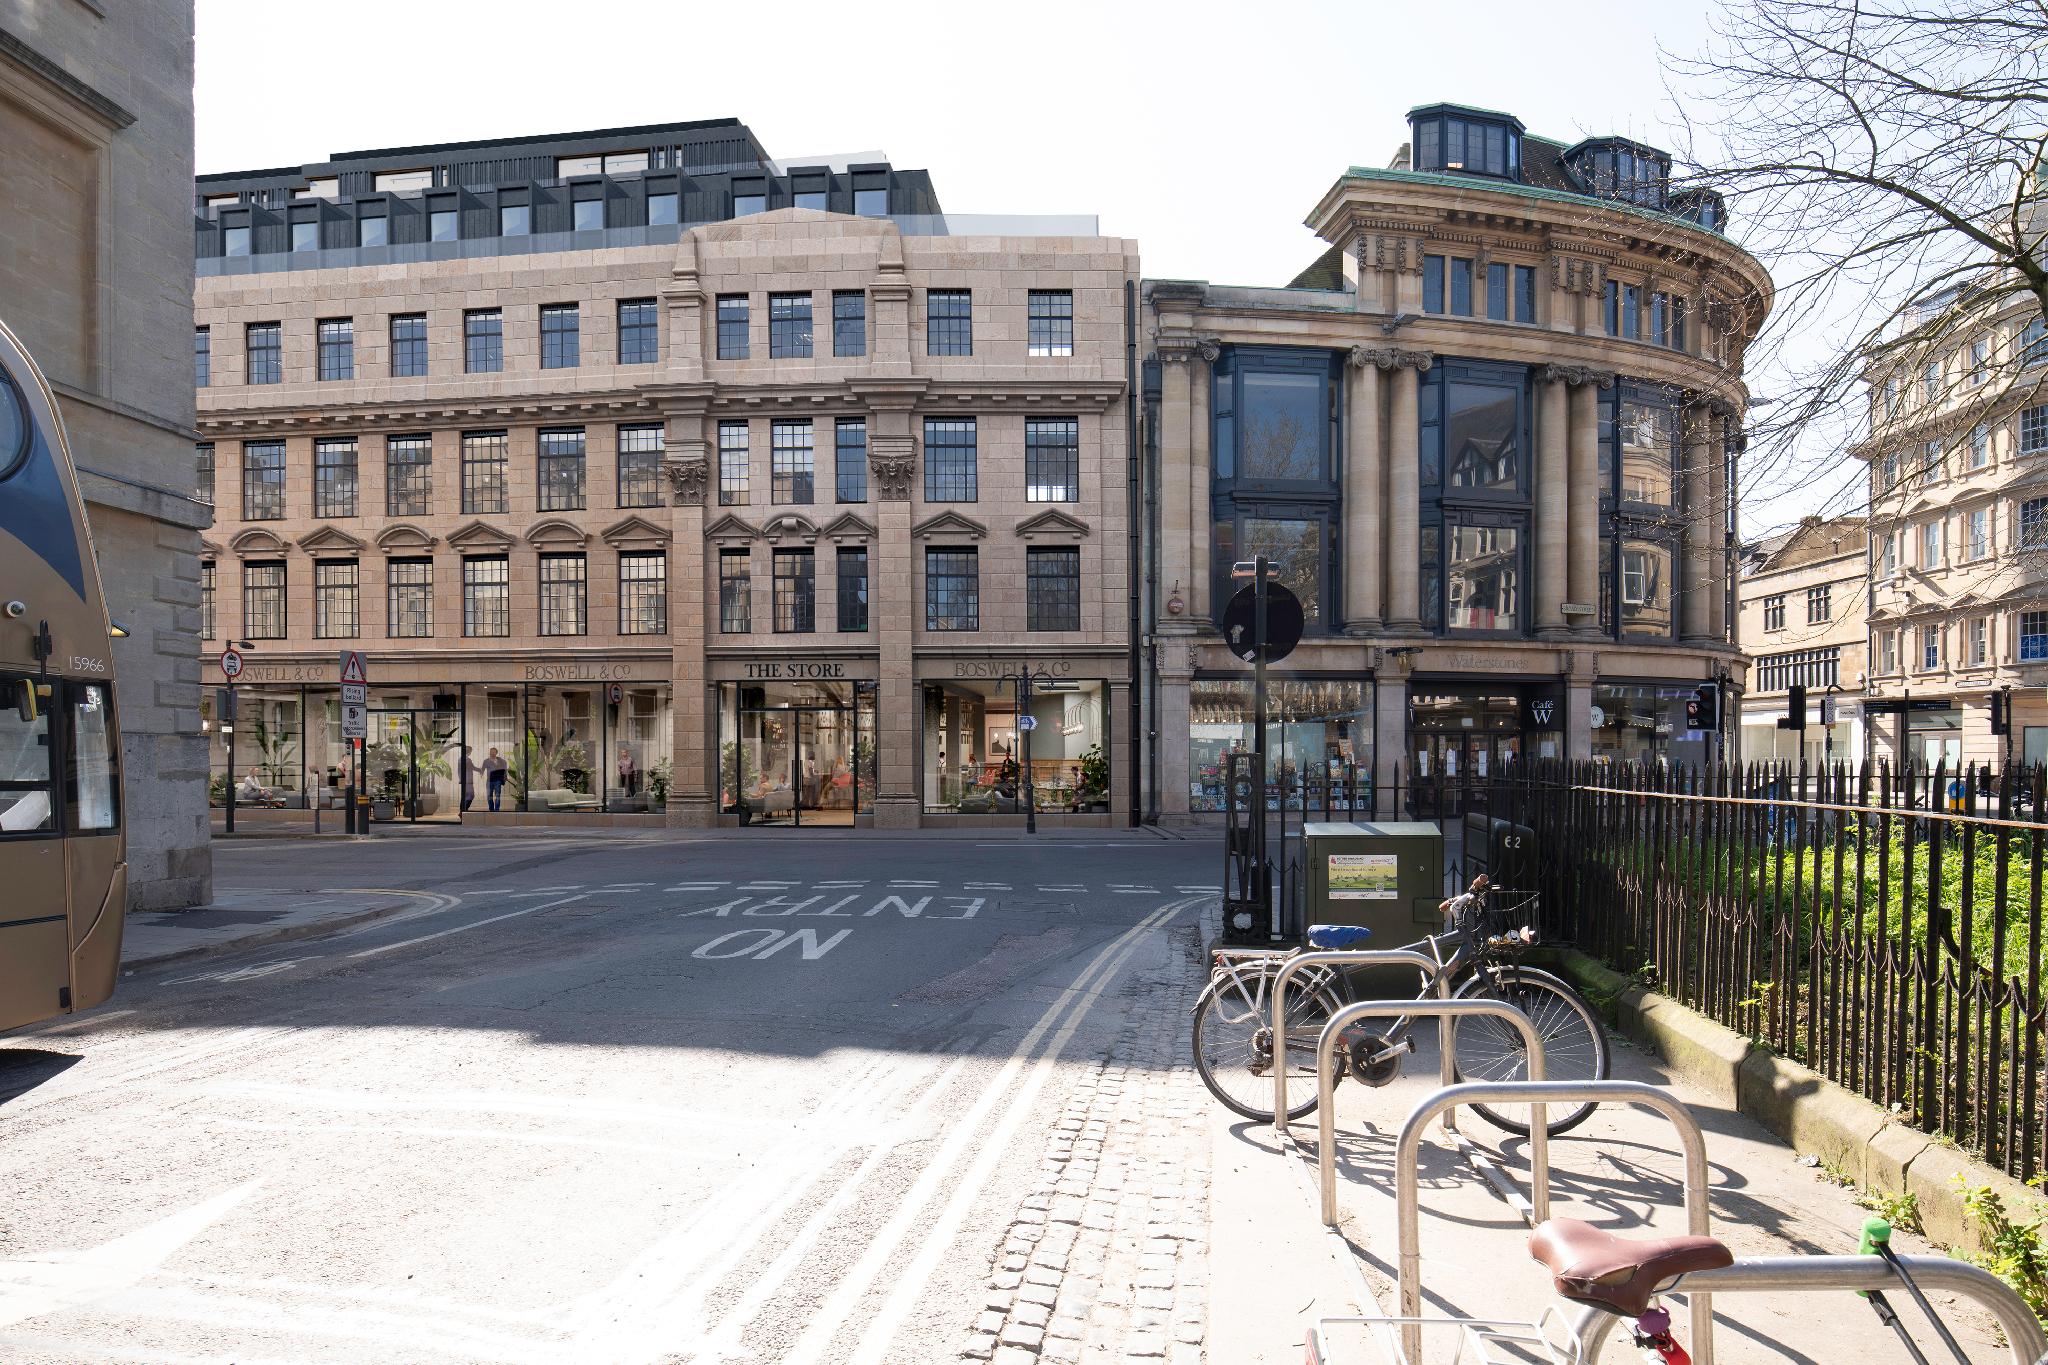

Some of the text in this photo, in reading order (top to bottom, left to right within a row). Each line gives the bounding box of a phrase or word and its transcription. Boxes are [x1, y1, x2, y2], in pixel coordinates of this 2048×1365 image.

[69, 656, 105, 672] 15966
[1036, 662, 1048, 676] &
[1447, 654, 1529, 670] Waterstones
[233, 667, 291, 681] OSWELL
[294, 667, 304, 681] &
[525, 665, 596, 680] BOSWELL
[599, 664, 609, 680] &
[745, 663, 844, 678] THE STORE
[1531, 700, 1554, 709] Café
[1532, 709, 1554, 725] W
[677, 895, 987, 919] ENTRY
[691, 928, 853, 960] NO
